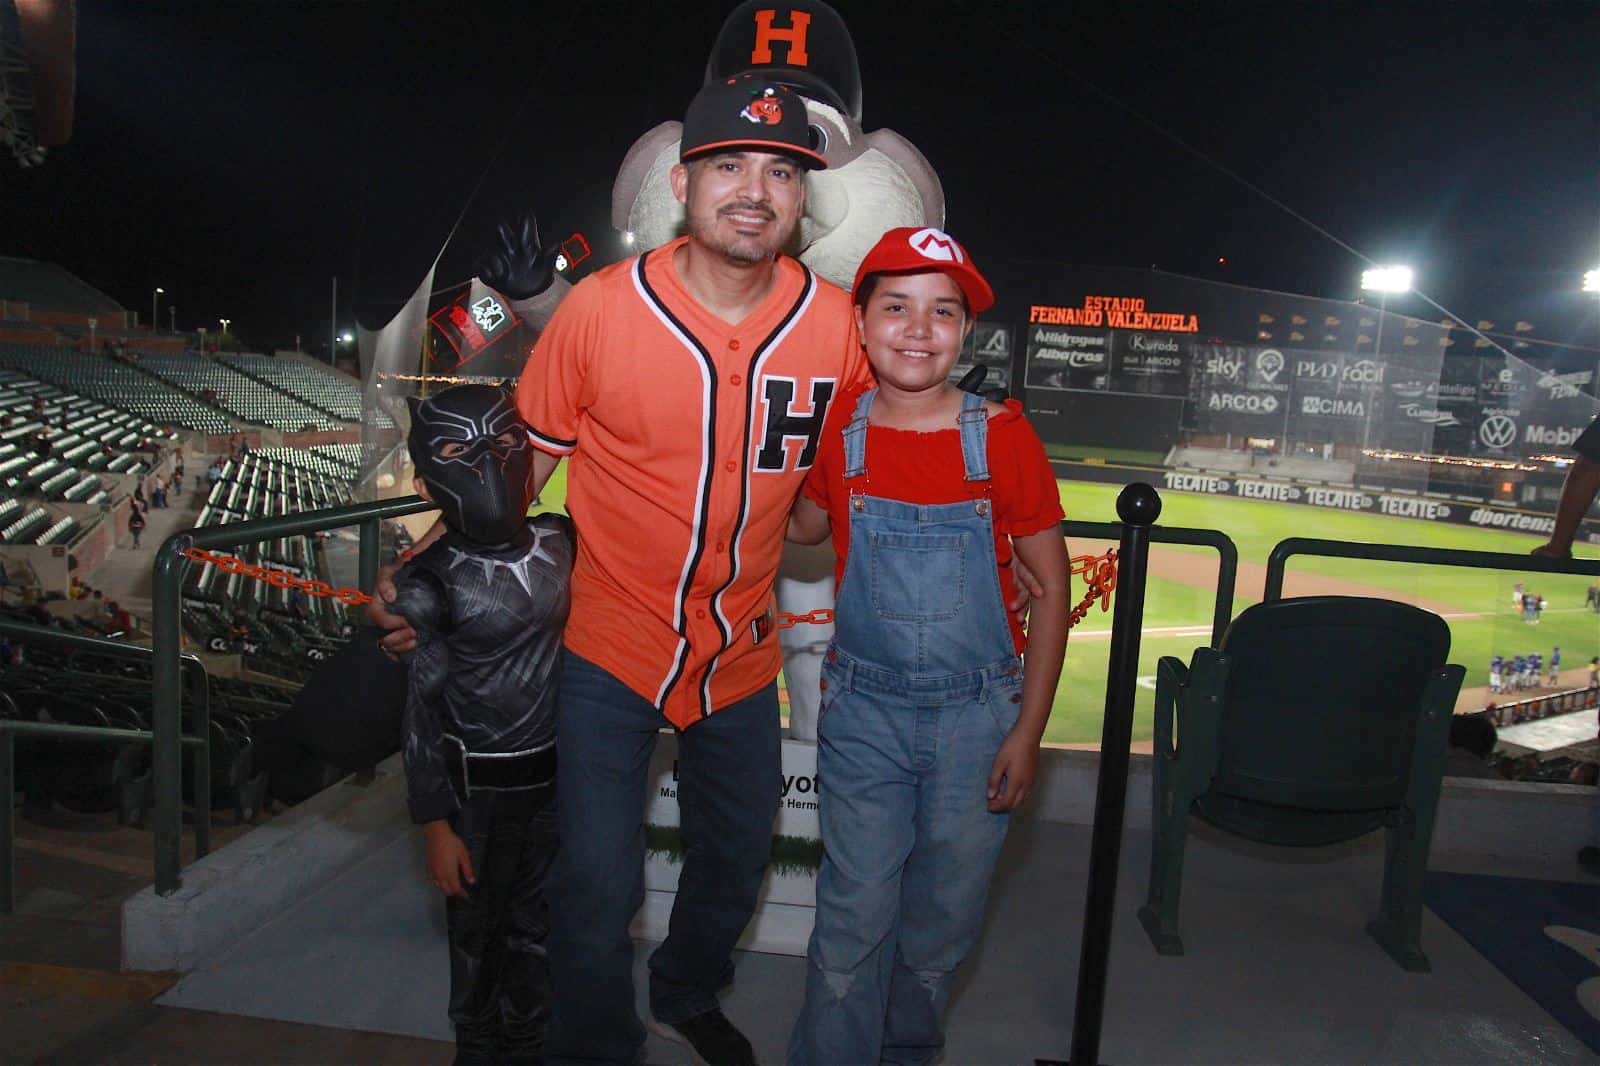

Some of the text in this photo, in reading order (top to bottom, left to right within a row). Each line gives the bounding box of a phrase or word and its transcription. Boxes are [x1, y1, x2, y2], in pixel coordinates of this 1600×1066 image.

[752, 9, 811, 66] H
[918, 232, 961, 264] M
[1084, 295, 1145, 312] ESTADIO
[1029, 305, 1199, 332] FERNANDO VALENZUELA
[1206, 356, 1242, 379] sky
[1208, 393, 1260, 410] ARCO
[1319, 399, 1365, 416] CIMA
[752, 374, 838, 473] H
[1164, 471, 1219, 492] TECATE
[1234, 479, 1290, 501] TECATE
[1305, 487, 1362, 509] TECATE
[1378, 494, 1439, 519] TECATE
